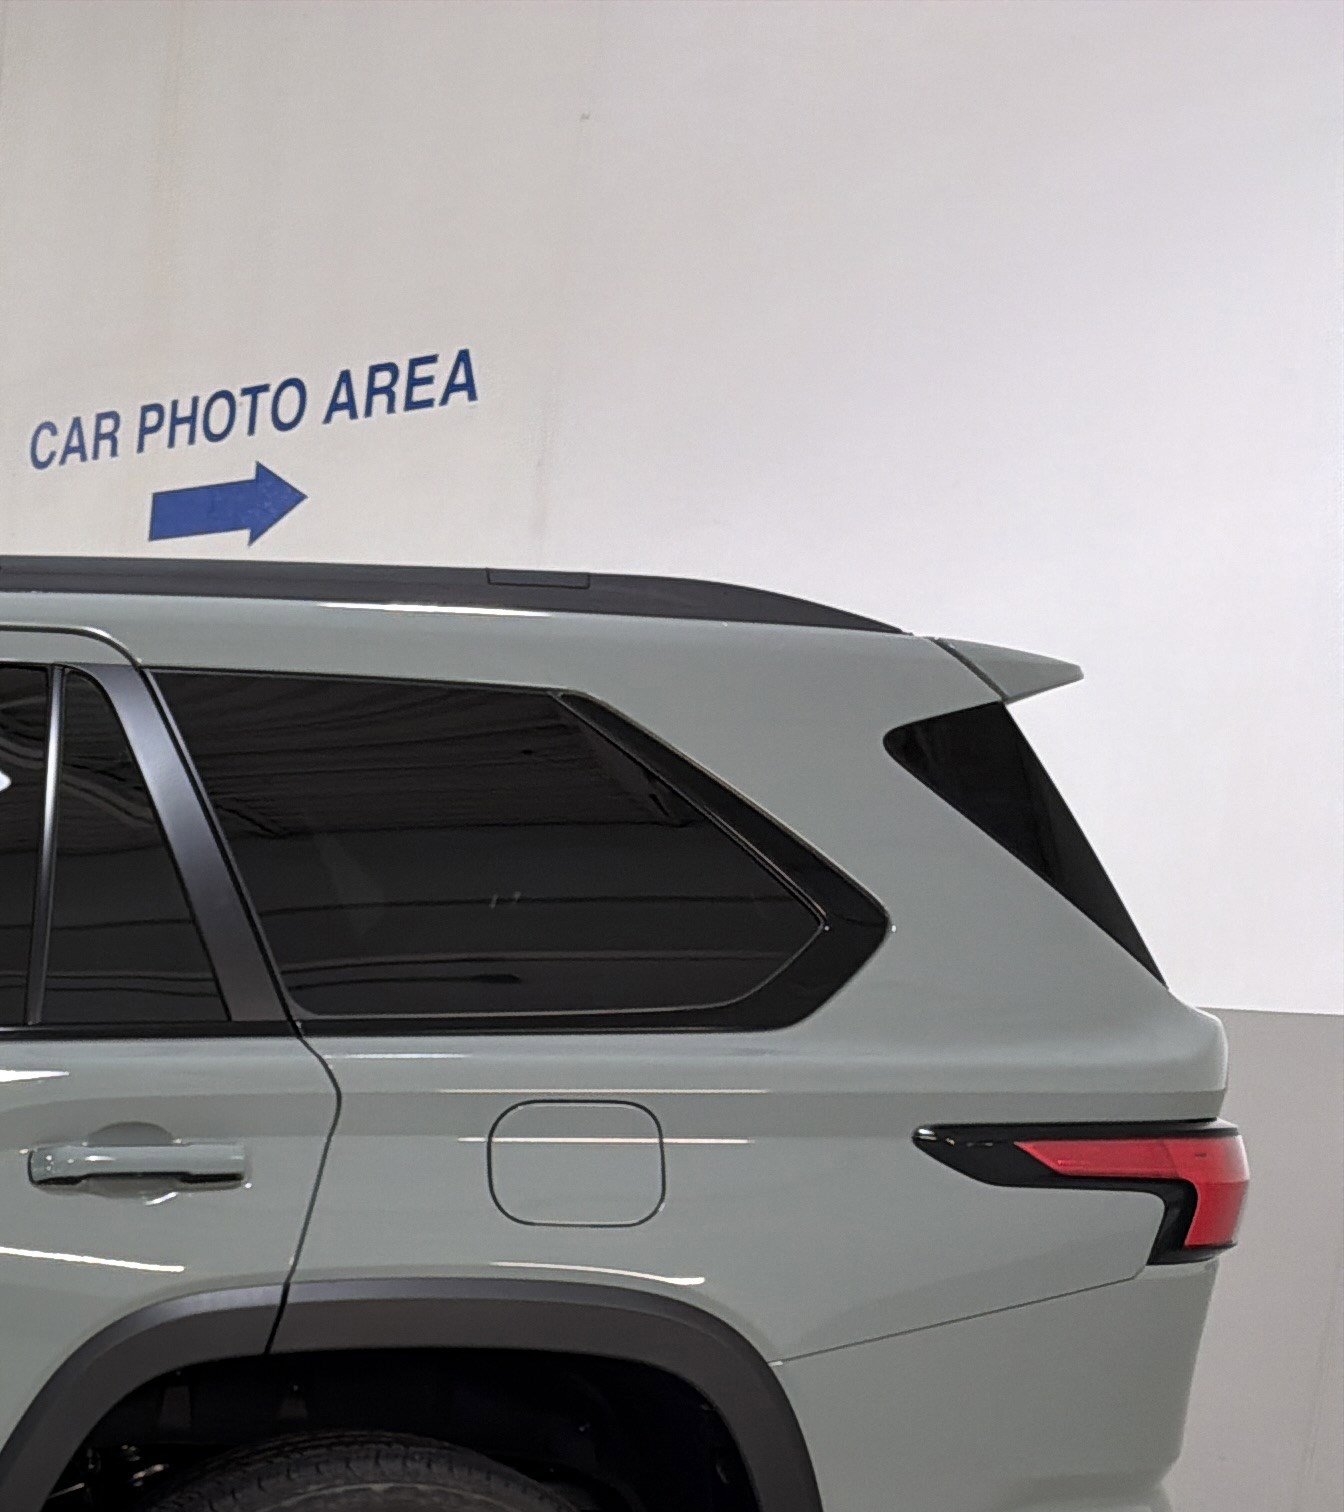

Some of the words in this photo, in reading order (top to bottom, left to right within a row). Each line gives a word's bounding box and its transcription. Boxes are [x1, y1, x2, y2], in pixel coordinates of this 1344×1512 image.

[29, 410, 121, 471] CAR
[136, 376, 308, 455] PHOTO
[322, 347, 479, 425] AREA
